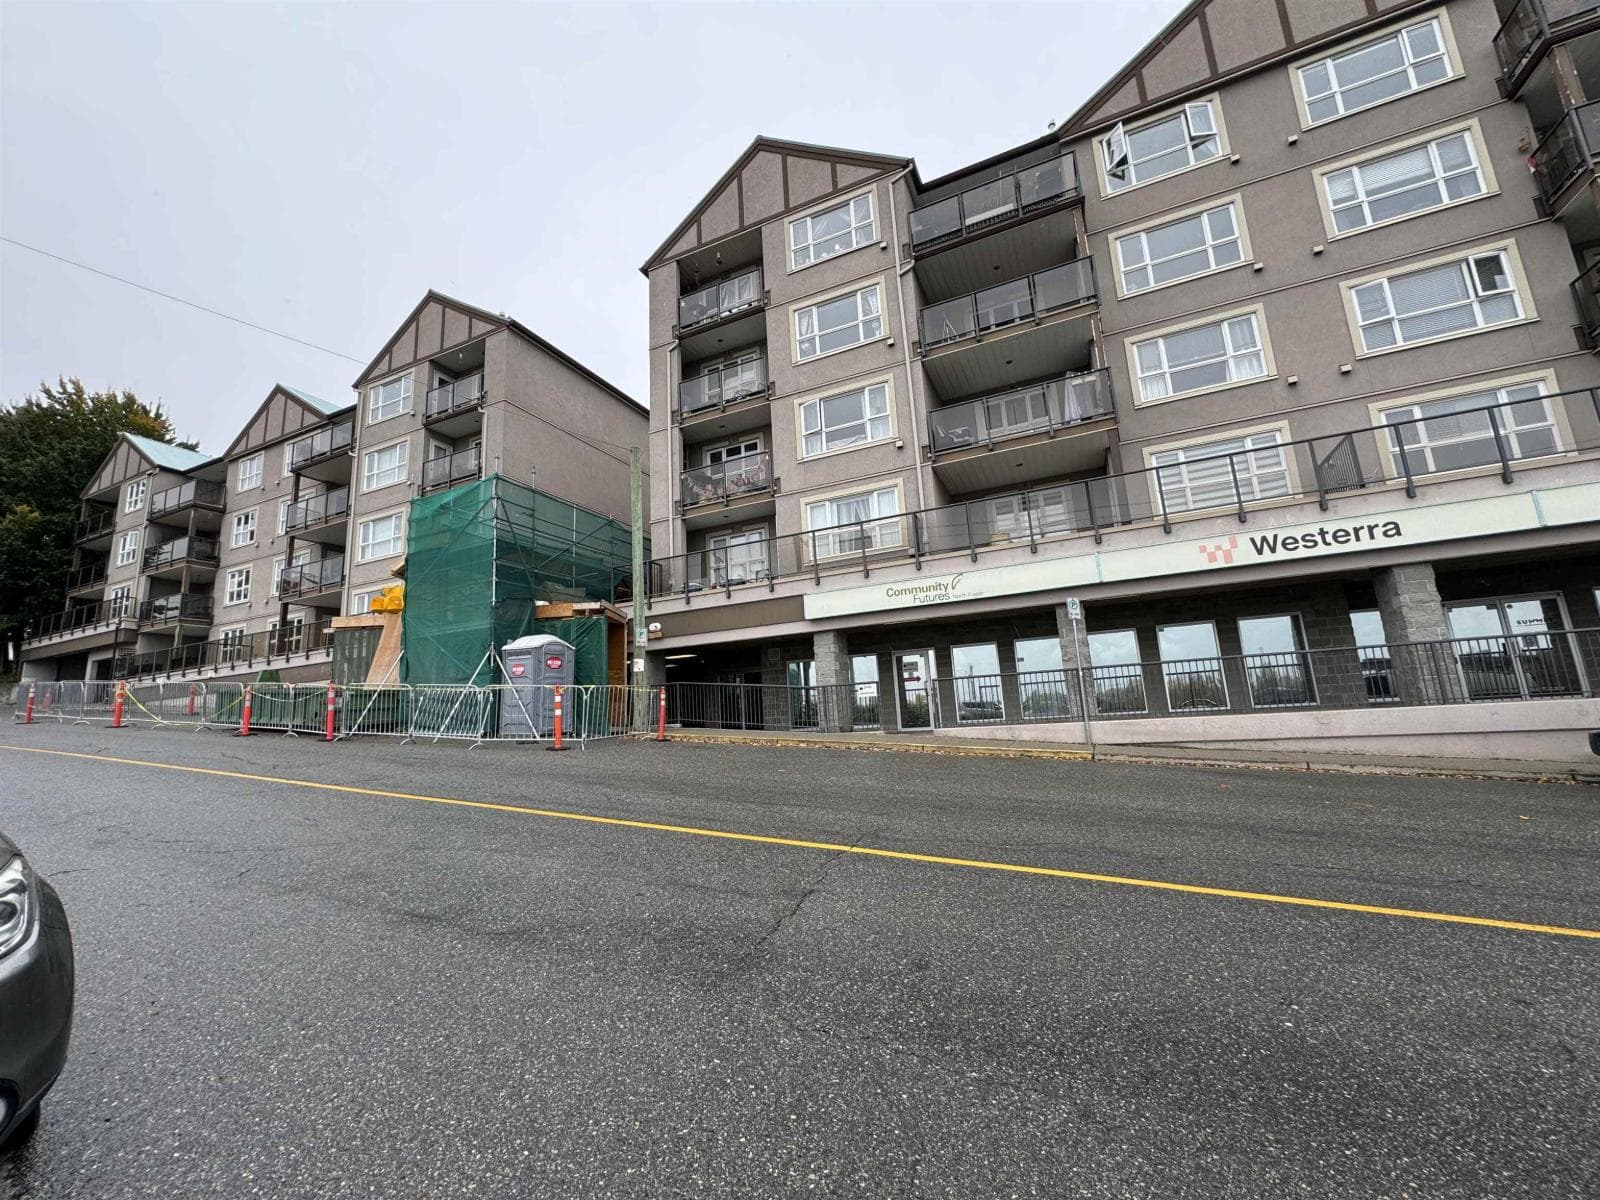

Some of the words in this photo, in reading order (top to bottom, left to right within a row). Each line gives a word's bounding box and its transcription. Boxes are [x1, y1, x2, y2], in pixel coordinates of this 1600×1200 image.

[1250, 520, 1402, 555] Westerra
[886, 582, 949, 597] Community
[913, 592, 950, 603] Futures
